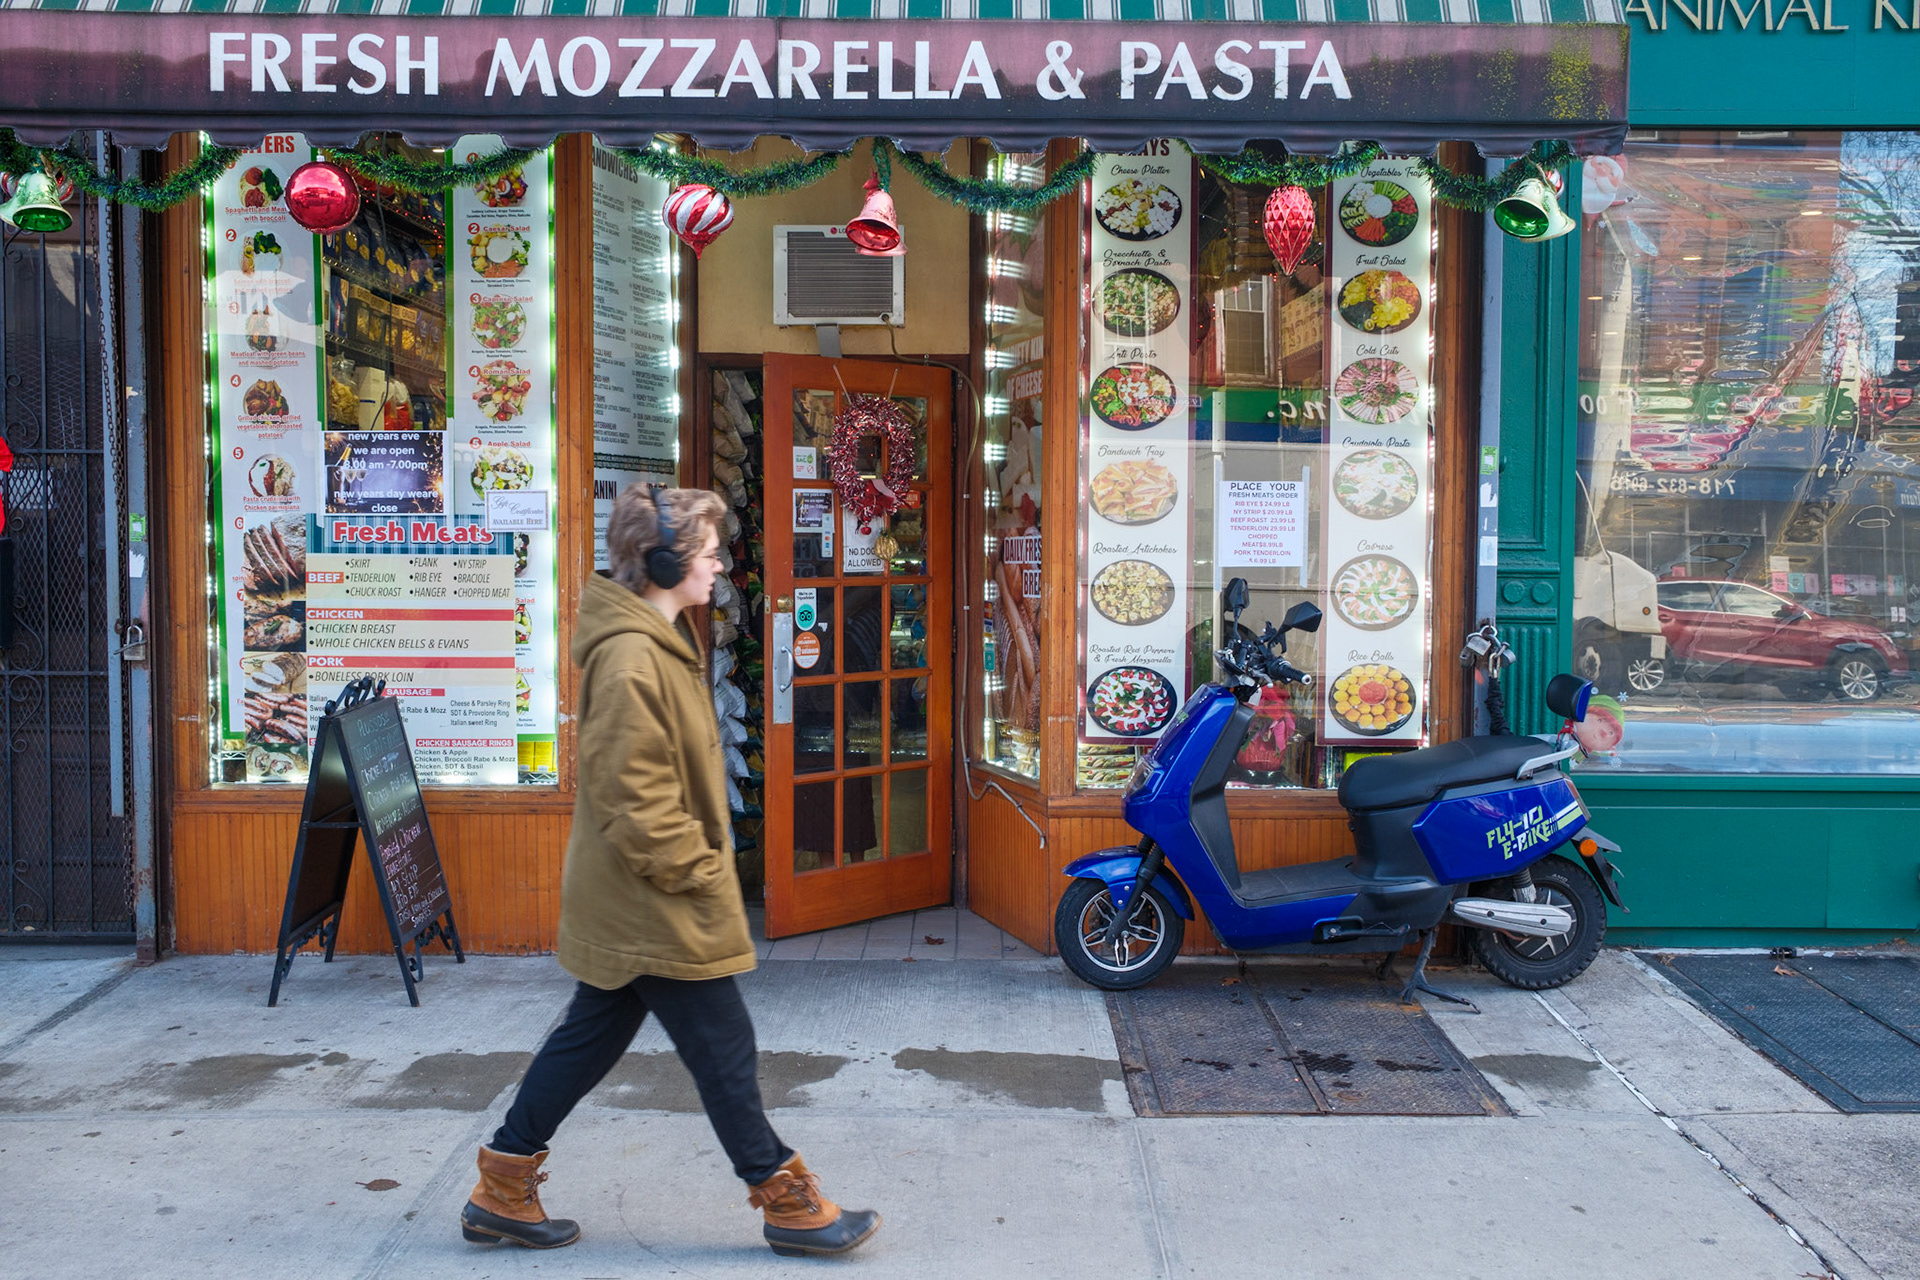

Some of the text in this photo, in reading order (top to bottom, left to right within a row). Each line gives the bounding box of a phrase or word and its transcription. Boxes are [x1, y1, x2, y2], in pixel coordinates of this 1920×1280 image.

[209, 32, 1353, 101] FRESH MOZZARELLA & PASTA
[1111, 165, 1170, 175] Cheese Platter
[1360, 166, 1401, 179] Vegetables
[1103, 249, 1166, 258] Orecchiette &
[1144, 257, 1171, 267] Pasta
[1356, 255, 1407, 266] Fruit Salad
[270, 351, 287, 359] green
[1356, 344, 1400, 356] Cold Cuts
[258, 415, 281, 423] chicken,
[282, 415, 301, 423] grilled
[258, 431, 283, 439] potatoes
[372, 433, 400, 442] years
[1386, 436, 1411, 448] Pasta
[389, 448, 415, 456] open
[1098, 445, 1165, 457] Sandwich Tray
[344, 461, 366, 469] 8.00
[594, 481, 617, 500] ANINI
[1230, 482, 1296, 491] PLACE YOUR
[334, 491, 355, 499] new
[357, 491, 384, 500] years
[386, 489, 405, 500] day
[371, 503, 398, 512] close
[333, 521, 493, 544] Fresh Meats
[861, 547, 876, 555] DOG
[1005, 538, 1023, 562] DAILY
[1092, 542, 1178, 555] Roasted Artichokes
[1356, 540, 1395, 552] Caprese
[350, 558, 487, 568] SKIRT FLANK NY STRIP
[308, 572, 490, 583] BEEF TENDERLION RIB EYE BRACIOLE
[351, 587, 510, 598] CHUCK ROAST HANGER CHOPPED MEAT
[307, 610, 363, 619] CHICKEN
[315, 624, 395, 634] CHICKEN BREAST
[316, 638, 469, 649] WHOLE CHICKEN BELLS & EVANS
[1089, 644, 1121, 654] Roasted
[1124, 645, 1141, 654] Red
[1094, 654, 1172, 665] & Fresh Mozzarella
[1348, 649, 1394, 662] Rice Balls
[308, 657, 345, 666] PORK
[386, 688, 432, 696] SAUSAGE
[477, 700, 496, 708] Parsley
[497, 700, 511, 708] Ring
[496, 710, 509, 718] Ring
[484, 719, 498, 727] Ring
[416, 739, 512, 747] CHICKEN SAUSAGE RINGS
[1502, 817, 1552, 860] E-BIKE
